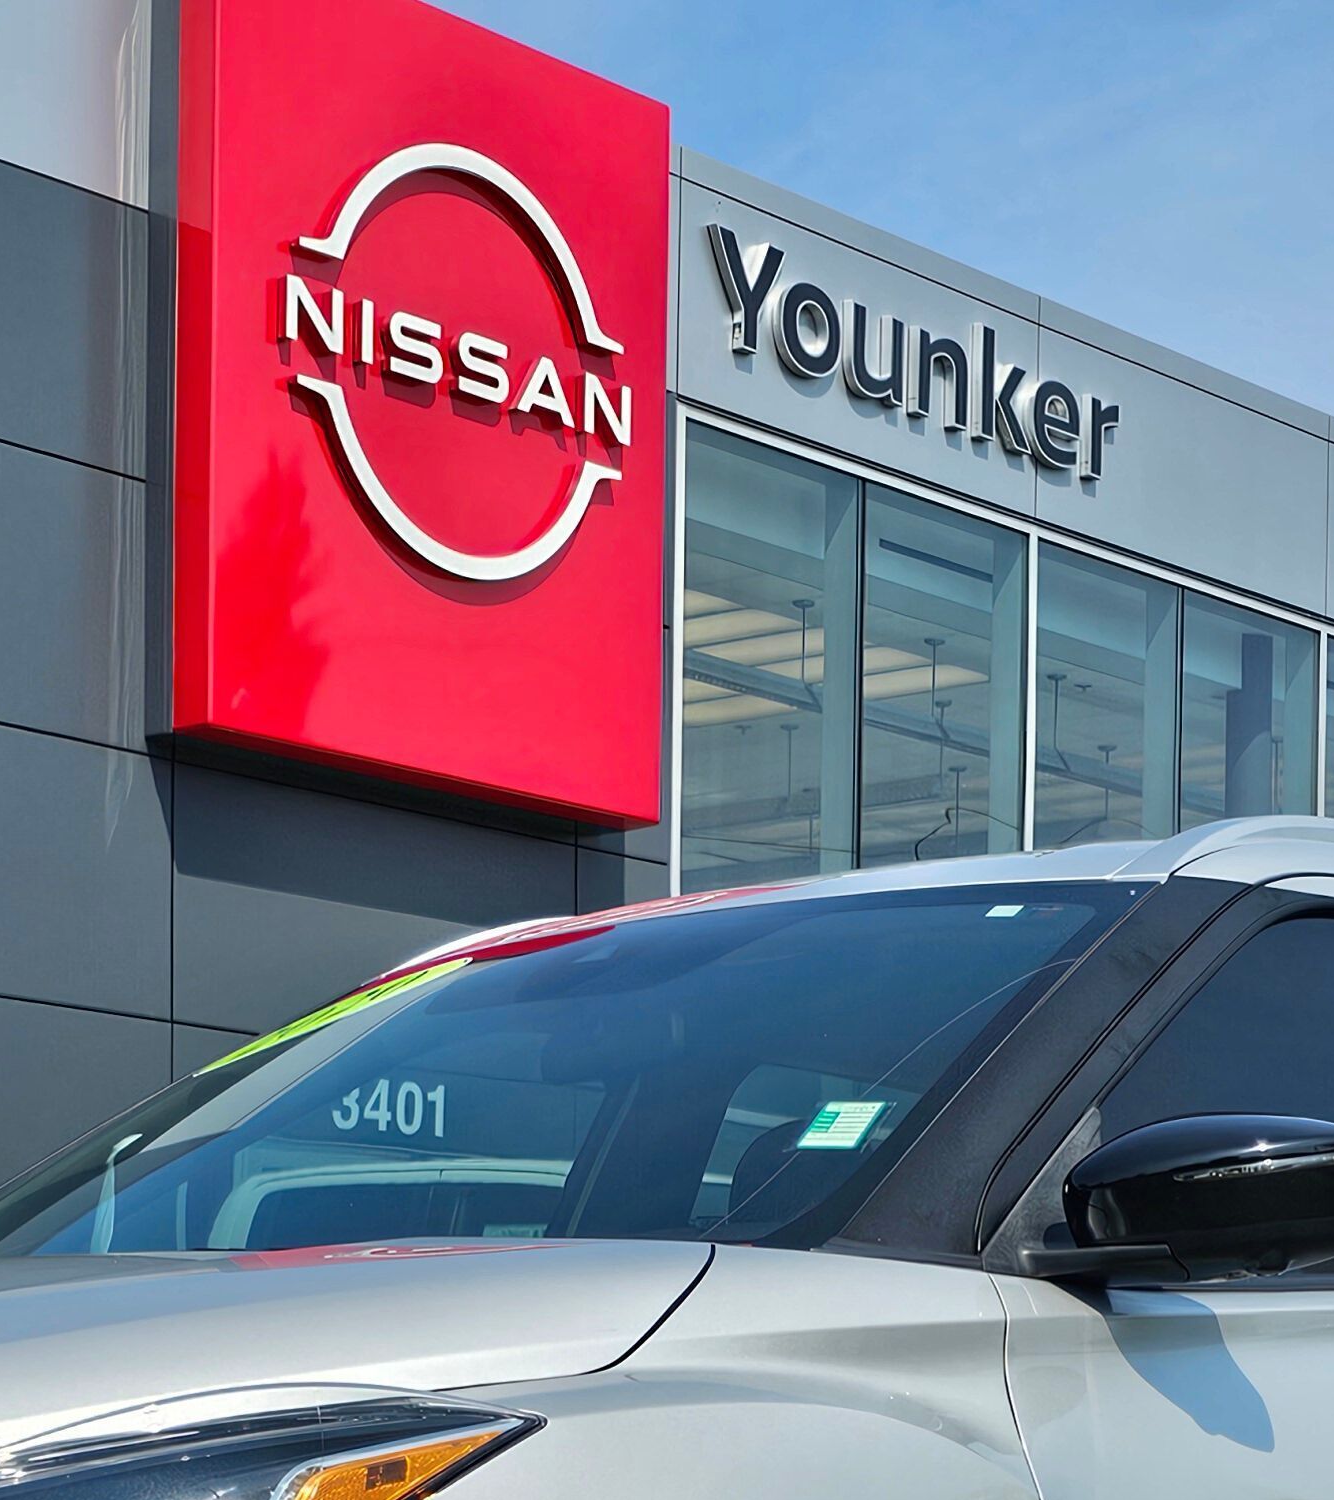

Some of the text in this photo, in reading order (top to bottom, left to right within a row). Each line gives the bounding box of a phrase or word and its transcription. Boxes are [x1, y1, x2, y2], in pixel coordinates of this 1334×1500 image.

[280, 273, 632, 447] NISSAN
[707, 223, 1120, 480] Younker
[332, 1078, 445, 1138] 3401
